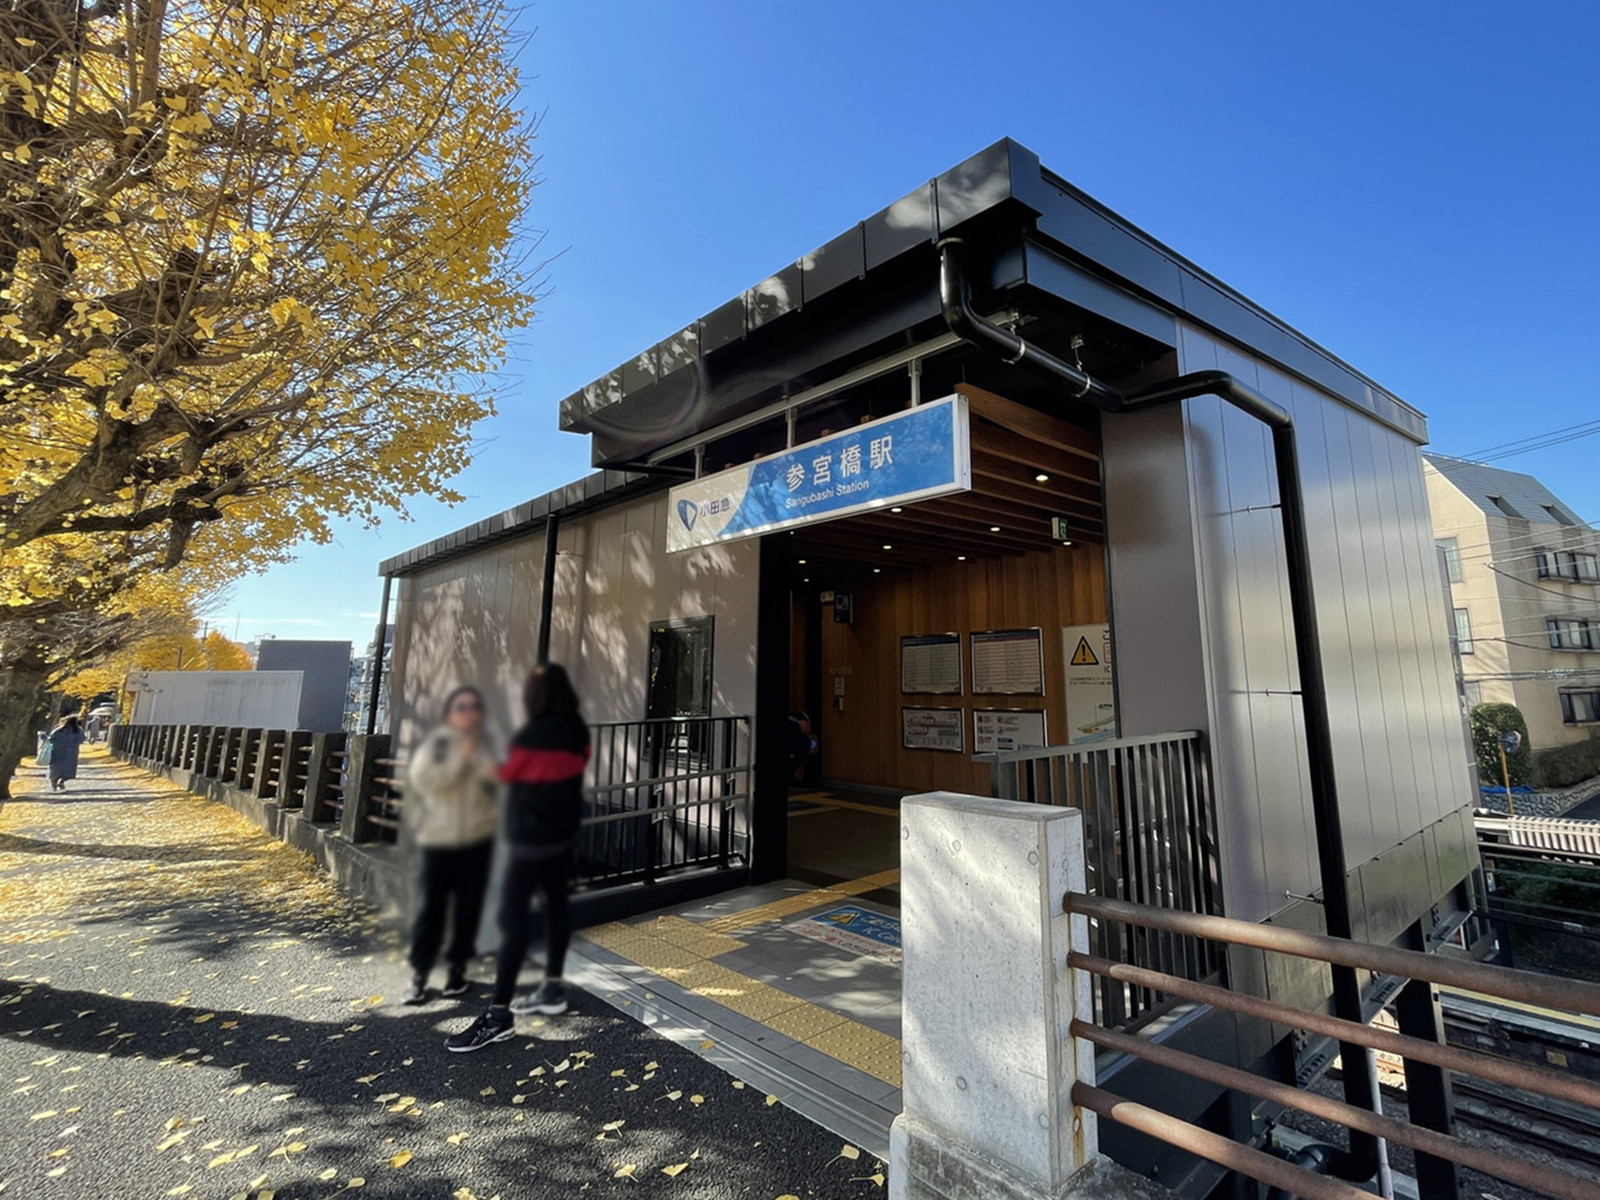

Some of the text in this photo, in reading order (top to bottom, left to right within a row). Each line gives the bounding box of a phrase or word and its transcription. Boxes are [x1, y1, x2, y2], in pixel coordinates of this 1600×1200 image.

[787, 435, 893, 493] 参宮橋駅
[700, 498, 730, 517] 小田急
[785, 480, 870, 509] Sangubashi Station
